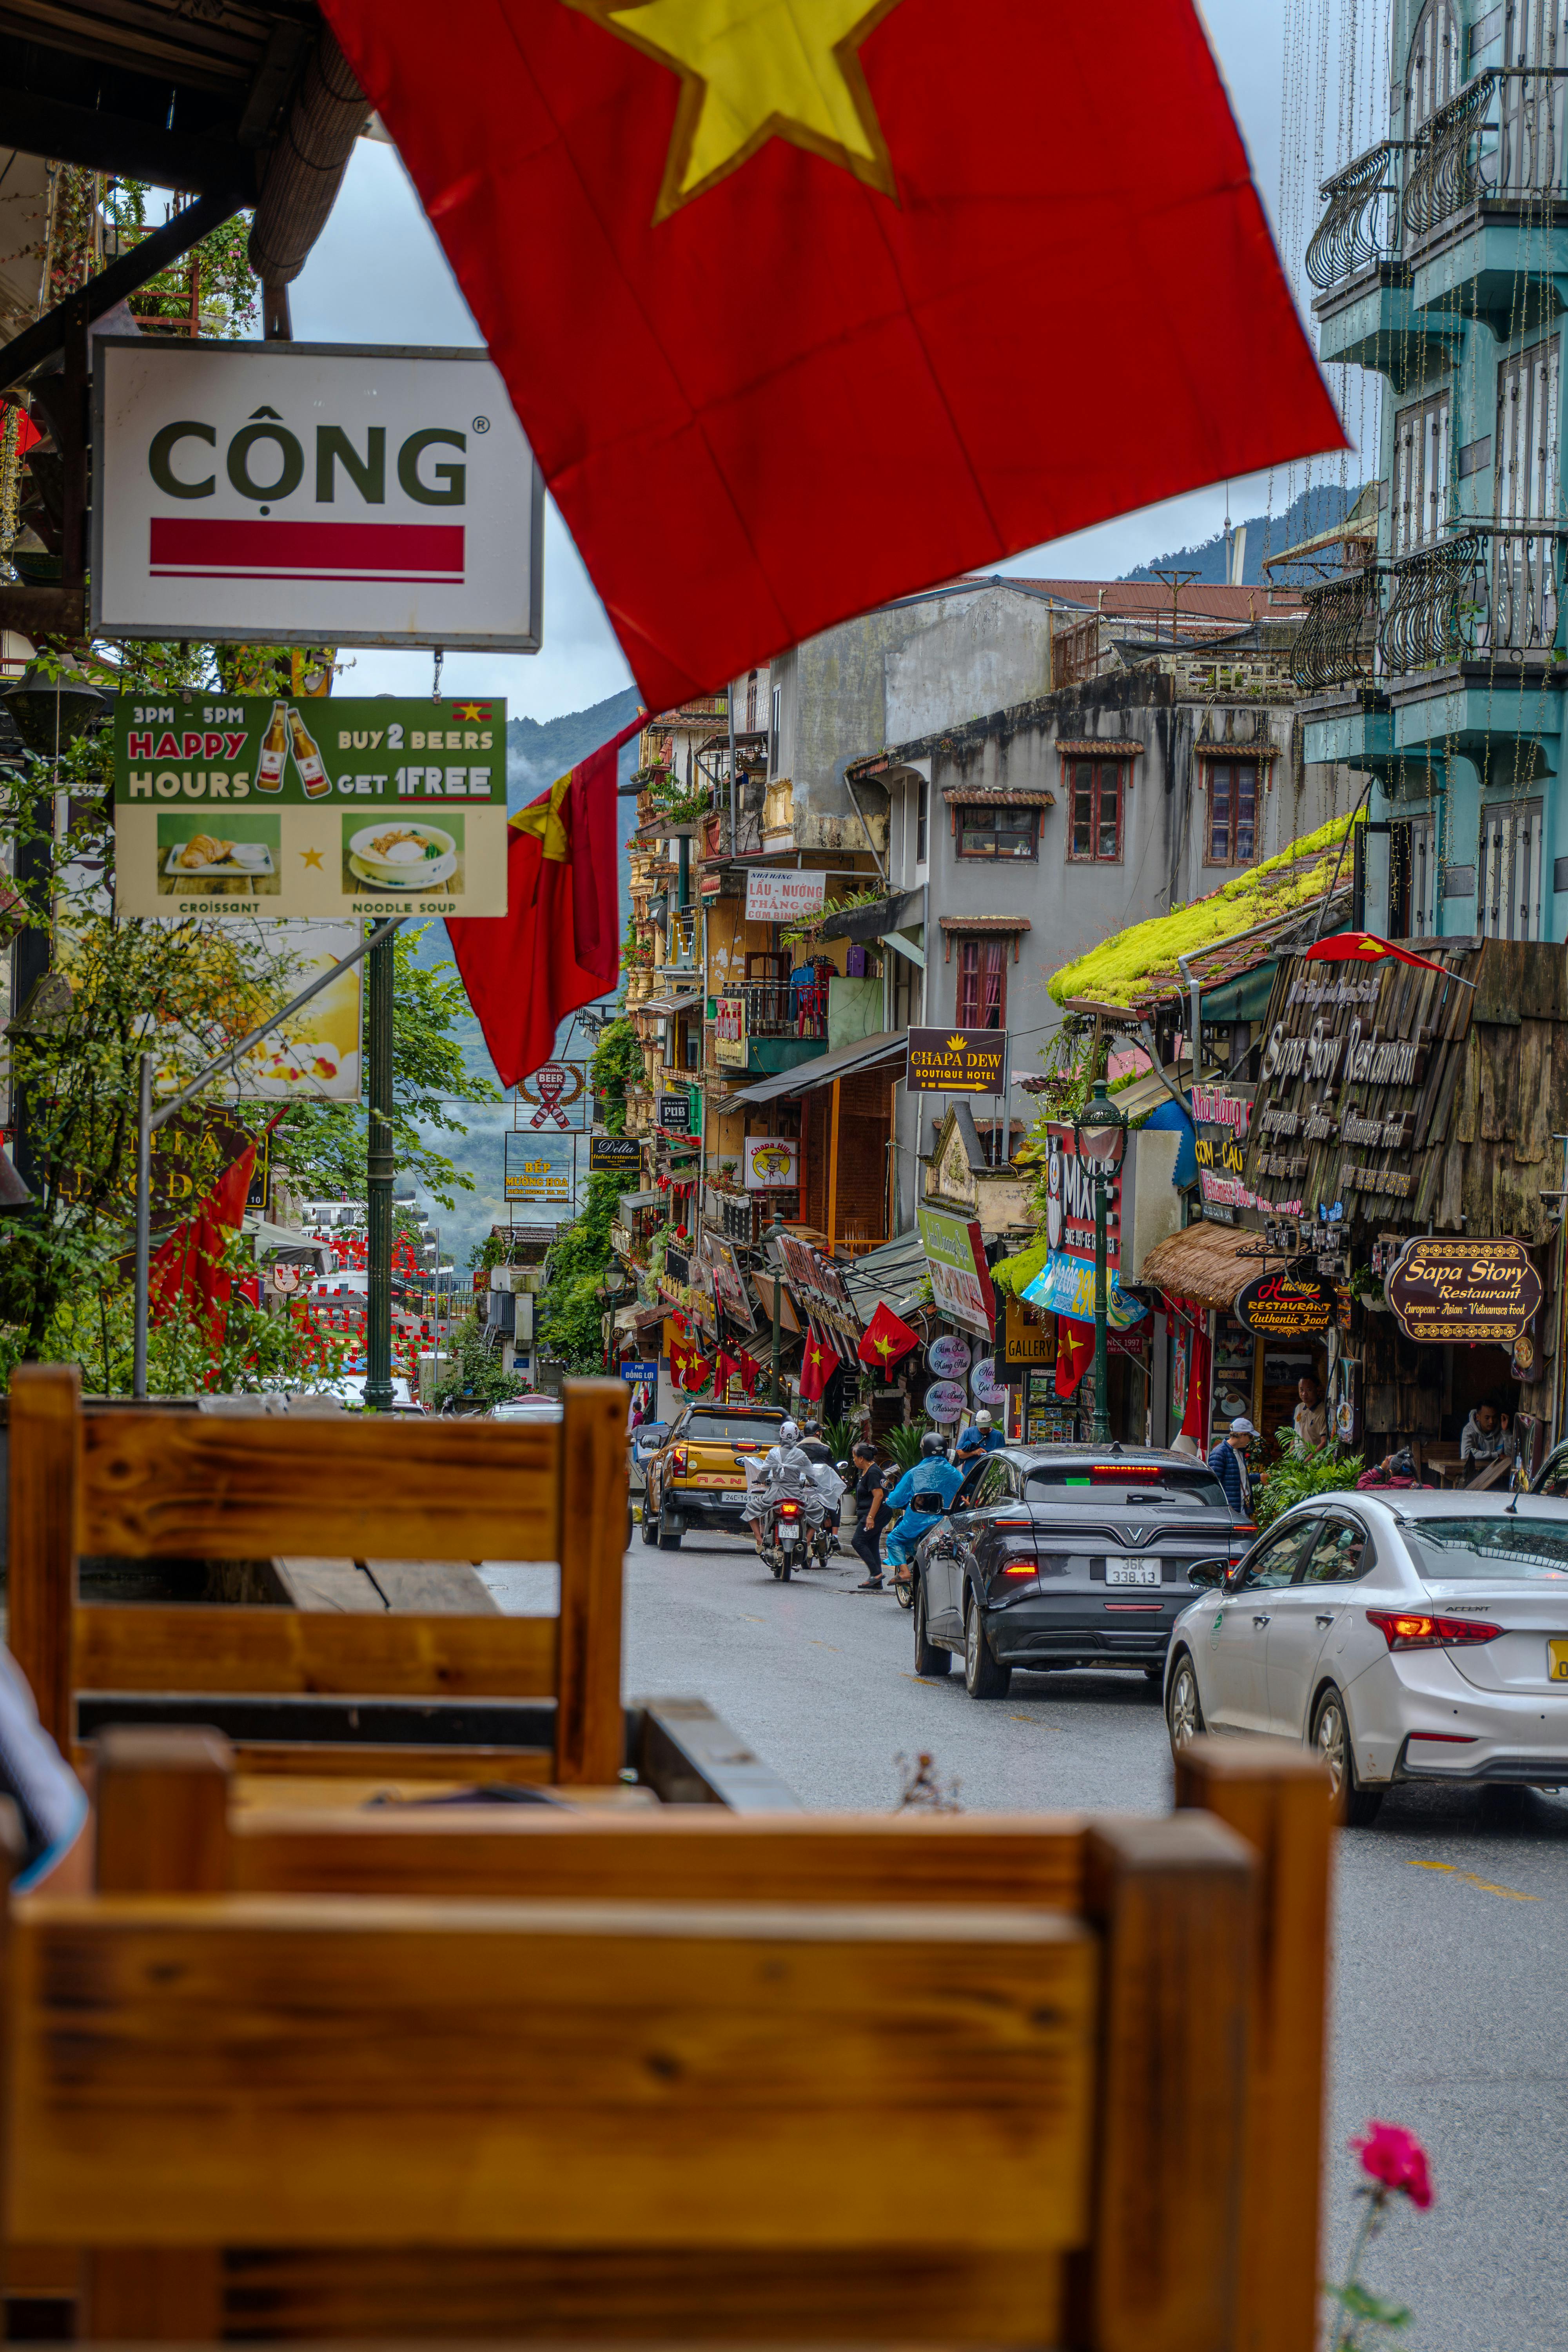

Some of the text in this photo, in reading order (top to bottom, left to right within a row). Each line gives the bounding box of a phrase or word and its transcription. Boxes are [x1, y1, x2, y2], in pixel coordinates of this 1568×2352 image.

[149, 406, 466, 516] CỘNG
[133, 707, 174, 723] 3PM
[203, 707, 244, 723] 5PM
[339, 723, 493, 750] BUY 2 BEERS
[128, 731, 249, 760] HAPPY
[129, 771, 250, 798] HOURS
[338, 774, 388, 794] GET
[782, 883, 823, 898] NƯỚNG
[352, 903, 456, 913] NOODLE SOUP
[911, 1051, 1002, 1068] CHAPA DEW
[1303, 1017, 1344, 1102] Story
[1343, 1015, 1421, 1086] Restaurant
[539, 1074, 563, 1083] BEER
[916, 1069, 996, 1080] BOUTIQUE HOTEL
[664, 1107, 686, 1116] PUB
[1191, 1084, 1211, 1122] Nhà
[1214, 1085, 1242, 1138] Hàng
[597, 1139, 635, 1153] Delta
[751, 1143, 775, 1156] Chapa
[524, 1158, 551, 1173] BẾP
[506, 1174, 568, 1187] MƯỜNG HOA
[1201, 1169, 1234, 1205] Vietnamese
[1065, 1227, 1074, 1247] SINCE
[955, 1229, 970, 1268] Spa
[1405, 1259, 1528, 1288] Sapa Story
[1439, 1285, 1521, 1299] Restaurant
[1248, 1301, 1331, 1311] RESTAURANT
[1508, 1303, 1526, 1315] Food
[1249, 1313, 1330, 1326] Authentic Food
[1009, 1340, 1053, 1356] GALLERY
[625, 1369, 654, 1380] ĐỒNG LỢI
[1218, 1370, 1248, 1379] COCKTAIL
[947, 1391, 964, 1403] Body
[1122, 1558, 1145, 1570] 36K
[1113, 1571, 1155, 1583] 338.13
